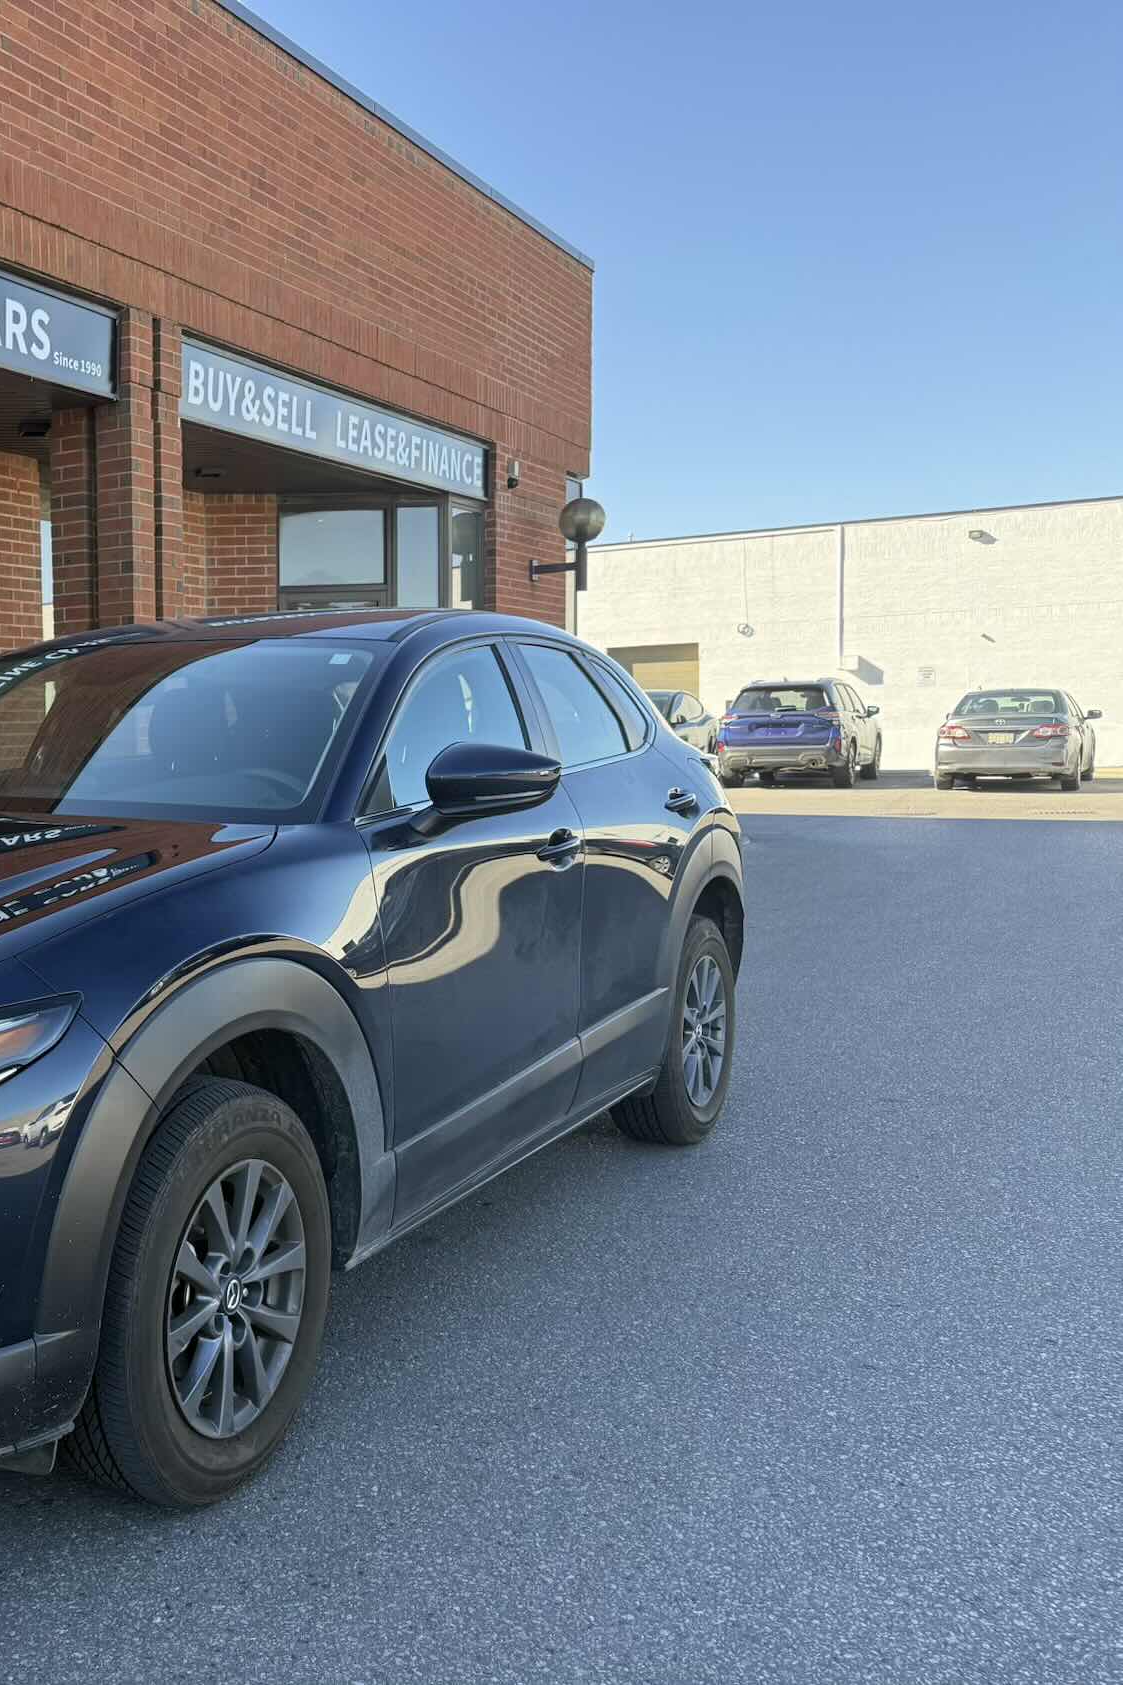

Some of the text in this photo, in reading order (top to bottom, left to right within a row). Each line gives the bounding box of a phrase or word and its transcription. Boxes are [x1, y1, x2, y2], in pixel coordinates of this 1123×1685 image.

[53, 352, 102, 377] Since 1990
[187, 359, 483, 486] BUY&SELL LEASE&FINANCE
